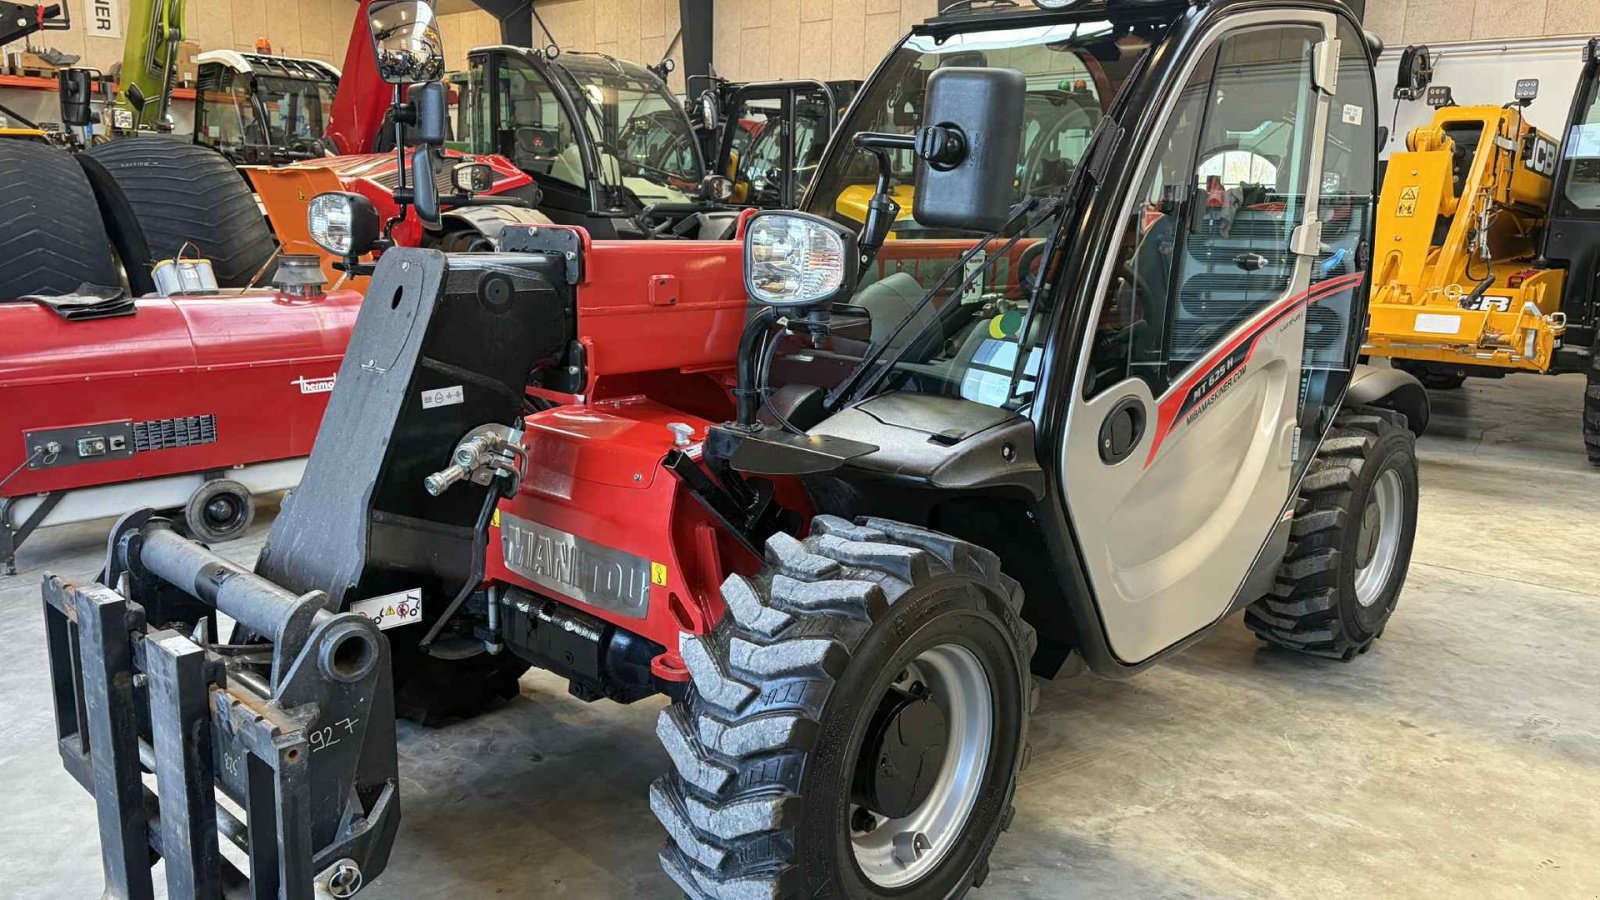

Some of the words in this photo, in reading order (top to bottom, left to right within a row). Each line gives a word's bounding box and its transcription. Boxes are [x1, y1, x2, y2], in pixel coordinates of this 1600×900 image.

[1526, 137, 1556, 176] JCB
[1186, 365, 1247, 427] MIBAMASKINER.COM
[1193, 384, 1209, 401] MT
[1209, 366, 1226, 386] 625
[1227, 356, 1234, 370] H
